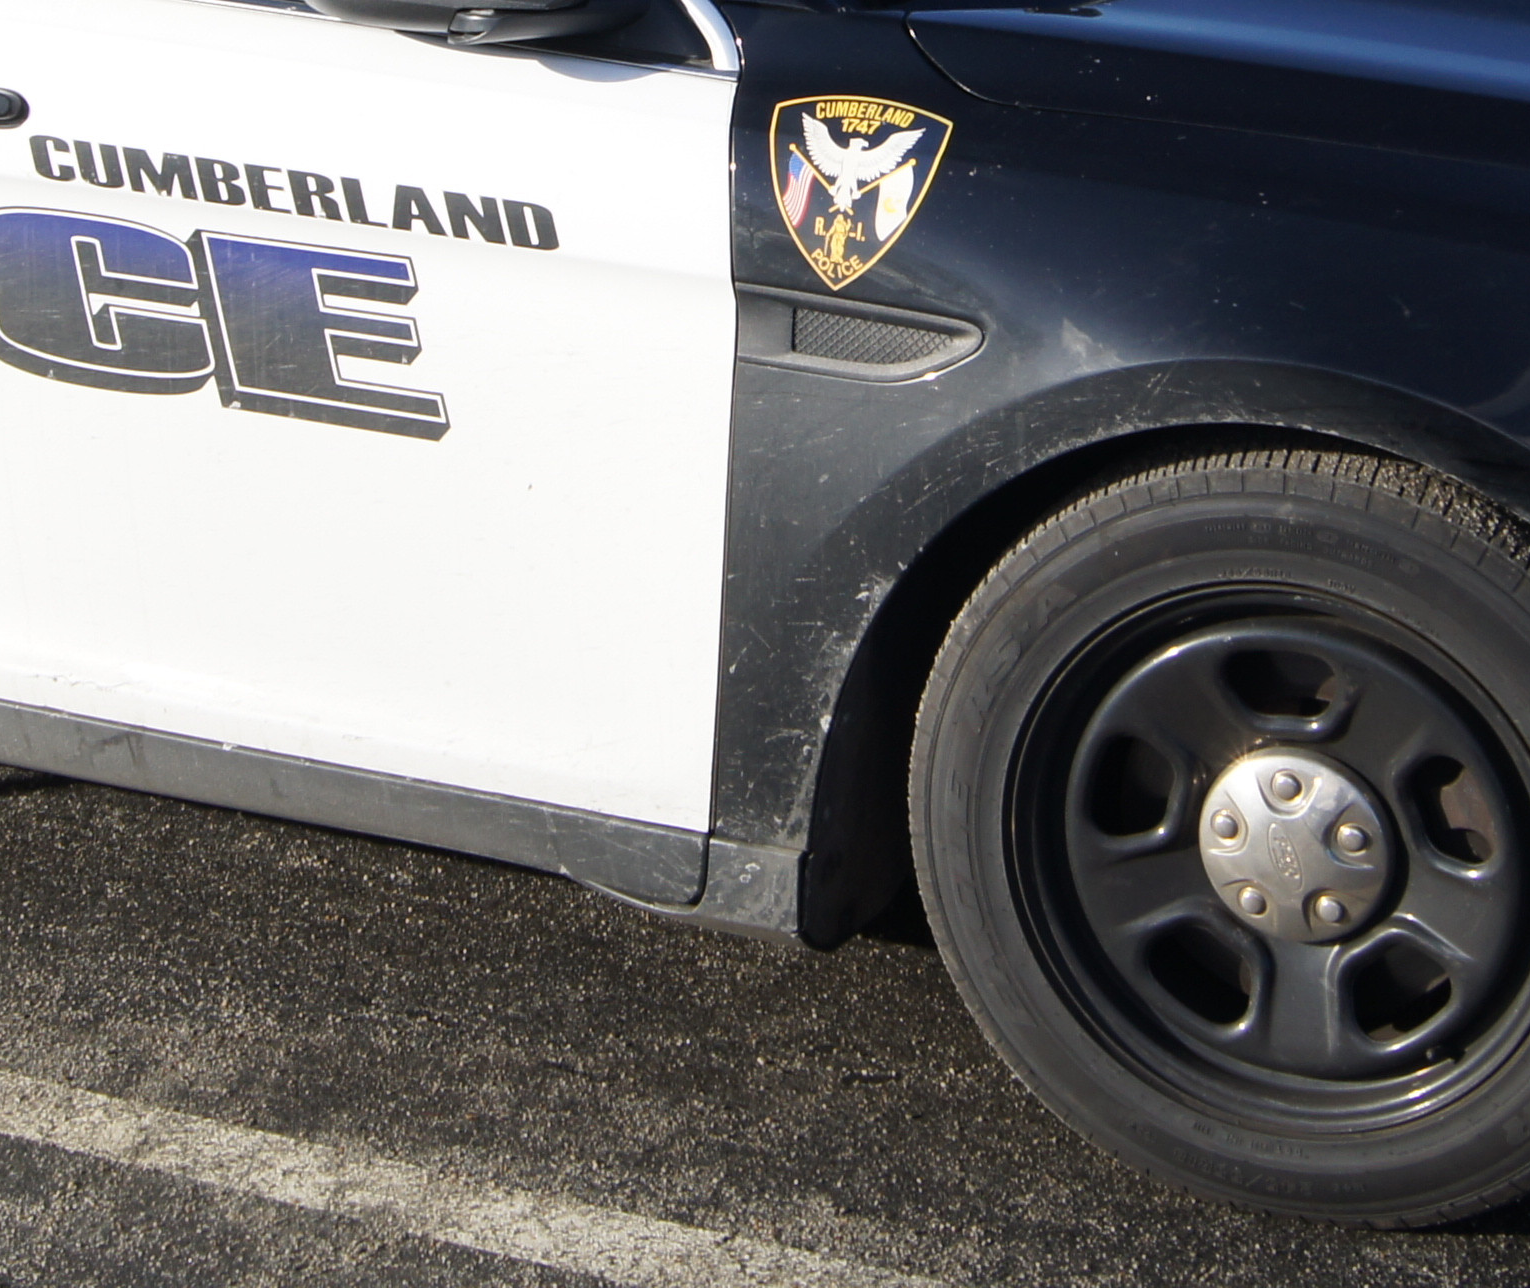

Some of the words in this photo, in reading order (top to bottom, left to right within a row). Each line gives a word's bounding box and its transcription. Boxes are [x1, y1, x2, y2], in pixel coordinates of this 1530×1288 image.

[816, 101, 915, 128] CUMBERLAND
[841, 119, 881, 135] 1747
[29, 134, 559, 250] CUMBERLAND
[811, 249, 863, 279] POLICE
